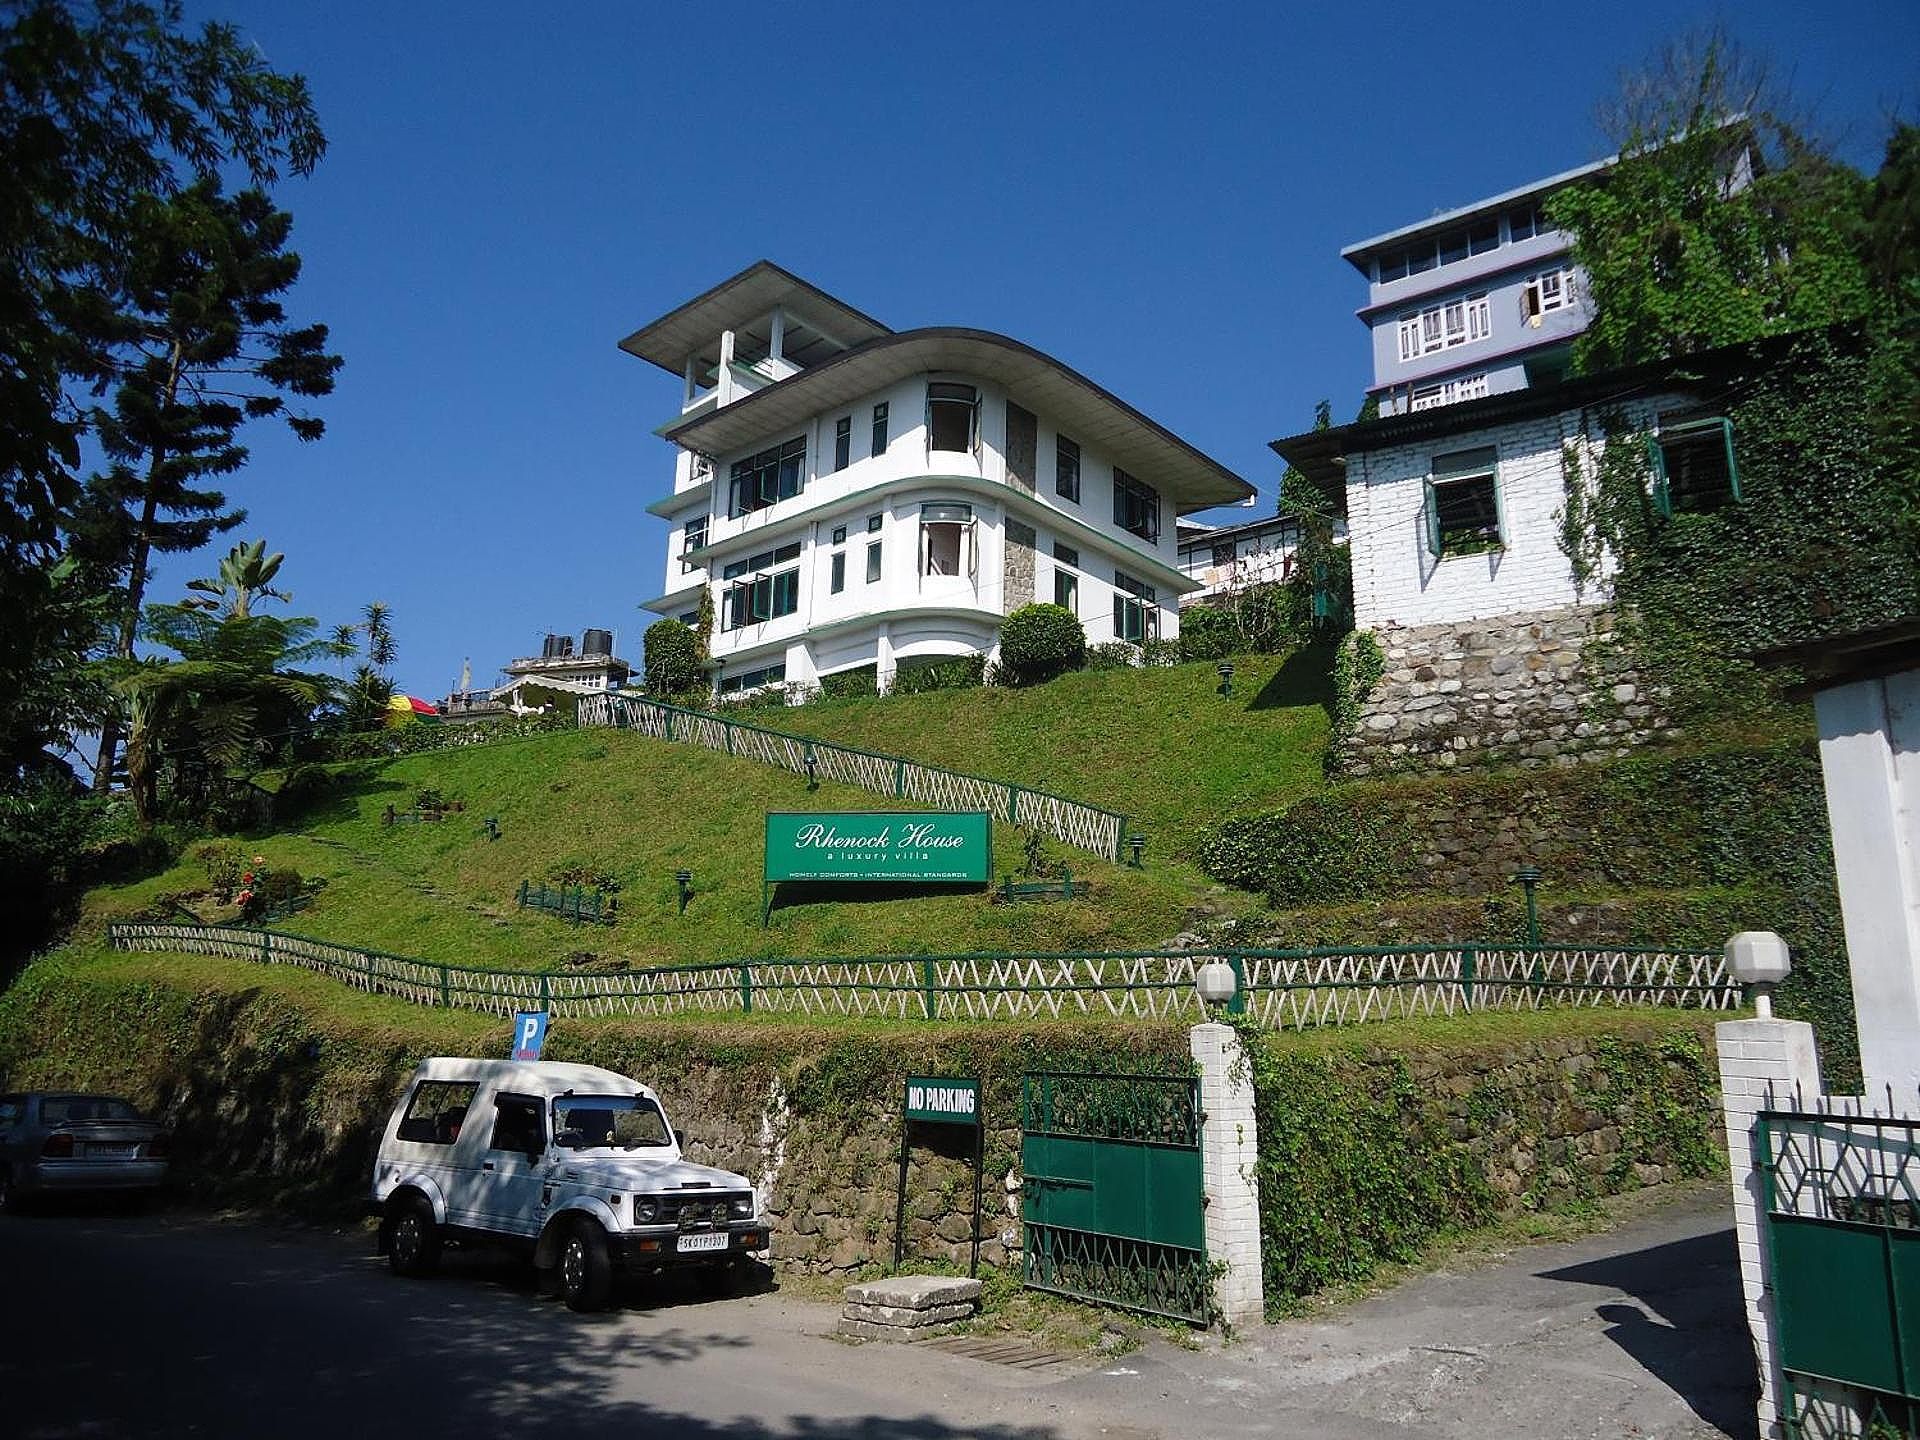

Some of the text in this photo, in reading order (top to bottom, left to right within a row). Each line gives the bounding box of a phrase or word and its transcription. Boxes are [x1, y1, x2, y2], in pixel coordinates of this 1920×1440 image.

[795, 823, 964, 848] Rhenock House
[827, 851, 929, 862] a luxury villa
[521, 1018, 539, 1050] P
[908, 1086, 975, 1114] NO PARKING
